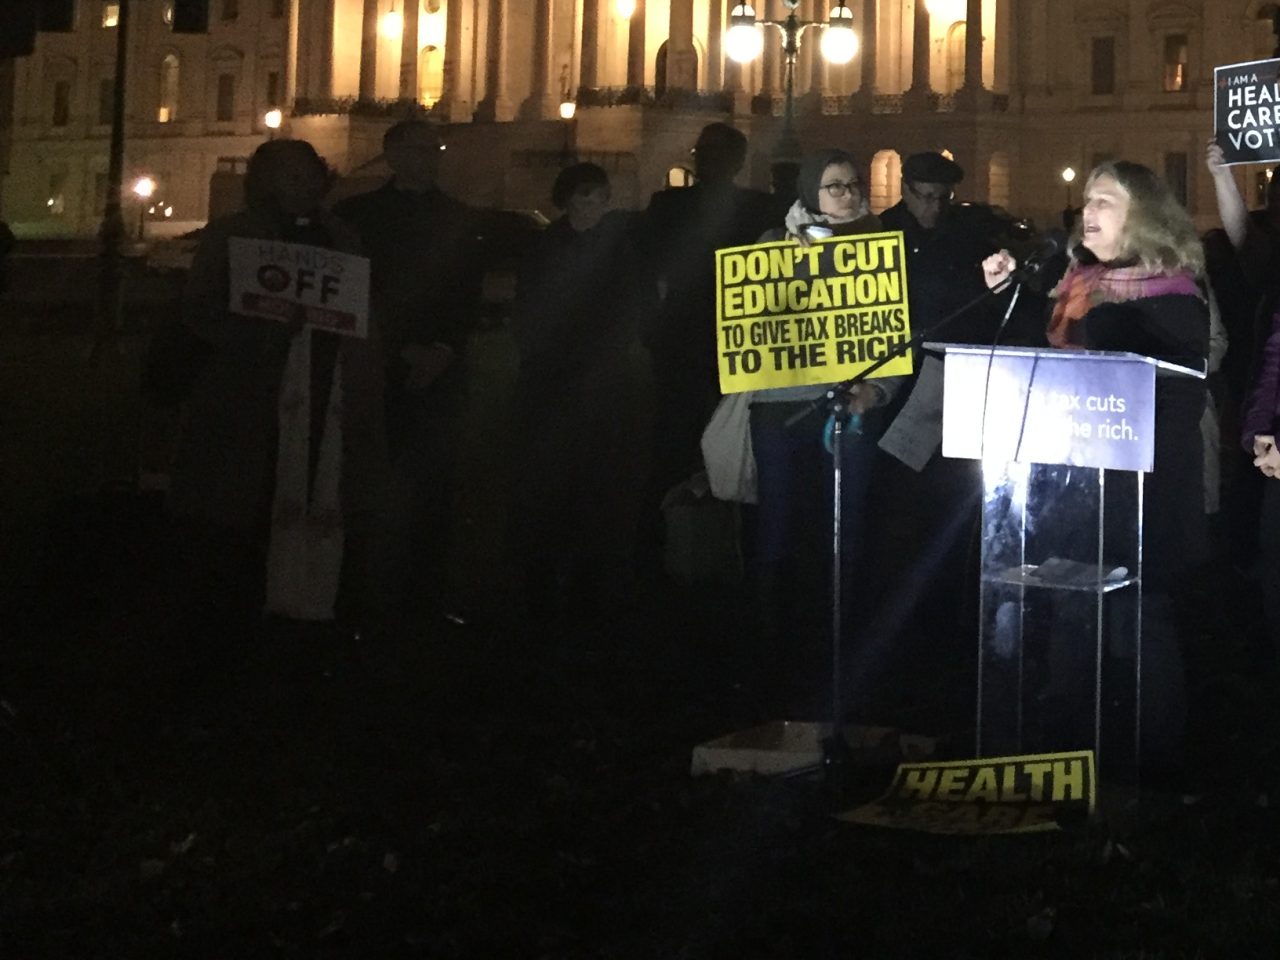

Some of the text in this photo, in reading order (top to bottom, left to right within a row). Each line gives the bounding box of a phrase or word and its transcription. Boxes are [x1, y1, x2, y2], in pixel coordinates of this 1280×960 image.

[1228, 73, 1258, 86] I AM A
[723, 239, 898, 285] DON'T CUT
[257, 264, 341, 304] OFF
[724, 271, 900, 318] EDUCATION
[722, 308, 906, 350] TO GIVE TAX BREAKS
[722, 334, 908, 375] TO THE RICH
[1086, 394, 1126, 413] cuts
[1098, 418, 1138, 441] rich.
[902, 758, 1084, 803] HEALTH
